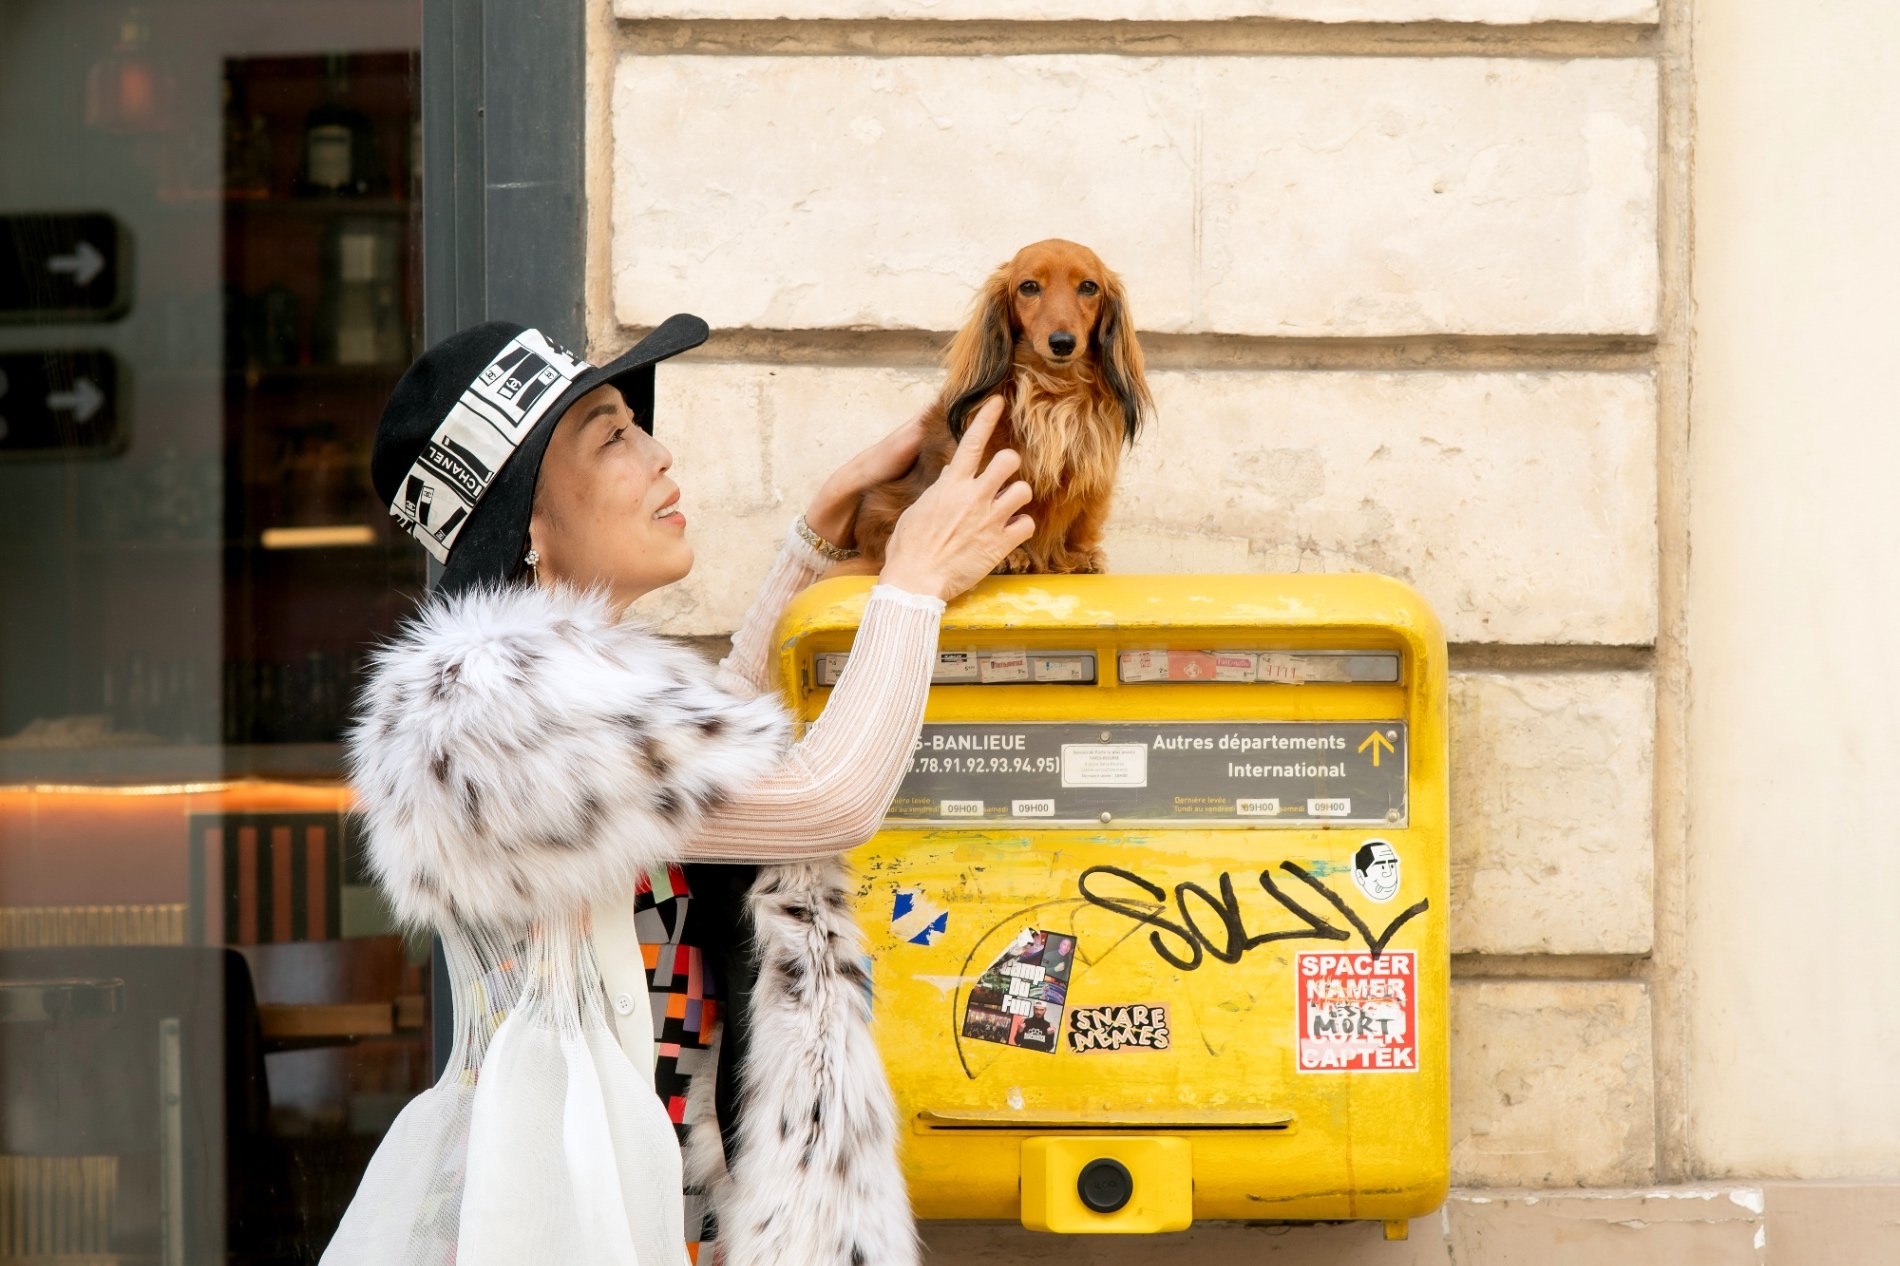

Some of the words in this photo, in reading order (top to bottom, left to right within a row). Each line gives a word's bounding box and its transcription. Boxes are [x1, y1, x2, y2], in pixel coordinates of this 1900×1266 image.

[429, 446, 476, 490] CHANEL
[914, 734, 1026, 750] S-BANLIEUE
[1153, 734, 1214, 750] Autres
[1218, 733, 1346, 753] départements
[907, 756, 1060, 774] 7.78.91.92.93.94.95)
[1228, 762, 1346, 777] International
[947, 804, 978, 813] 09H00
[1018, 803, 1049, 813] 09H00
[1243, 802, 1274, 812] 09H00
[1314, 802, 1345, 812] 09H00
[1302, 955, 1410, 976] SPACER
[1074, 1005, 1166, 1030] SNARE
[1313, 1013, 1395, 1036] MORT
